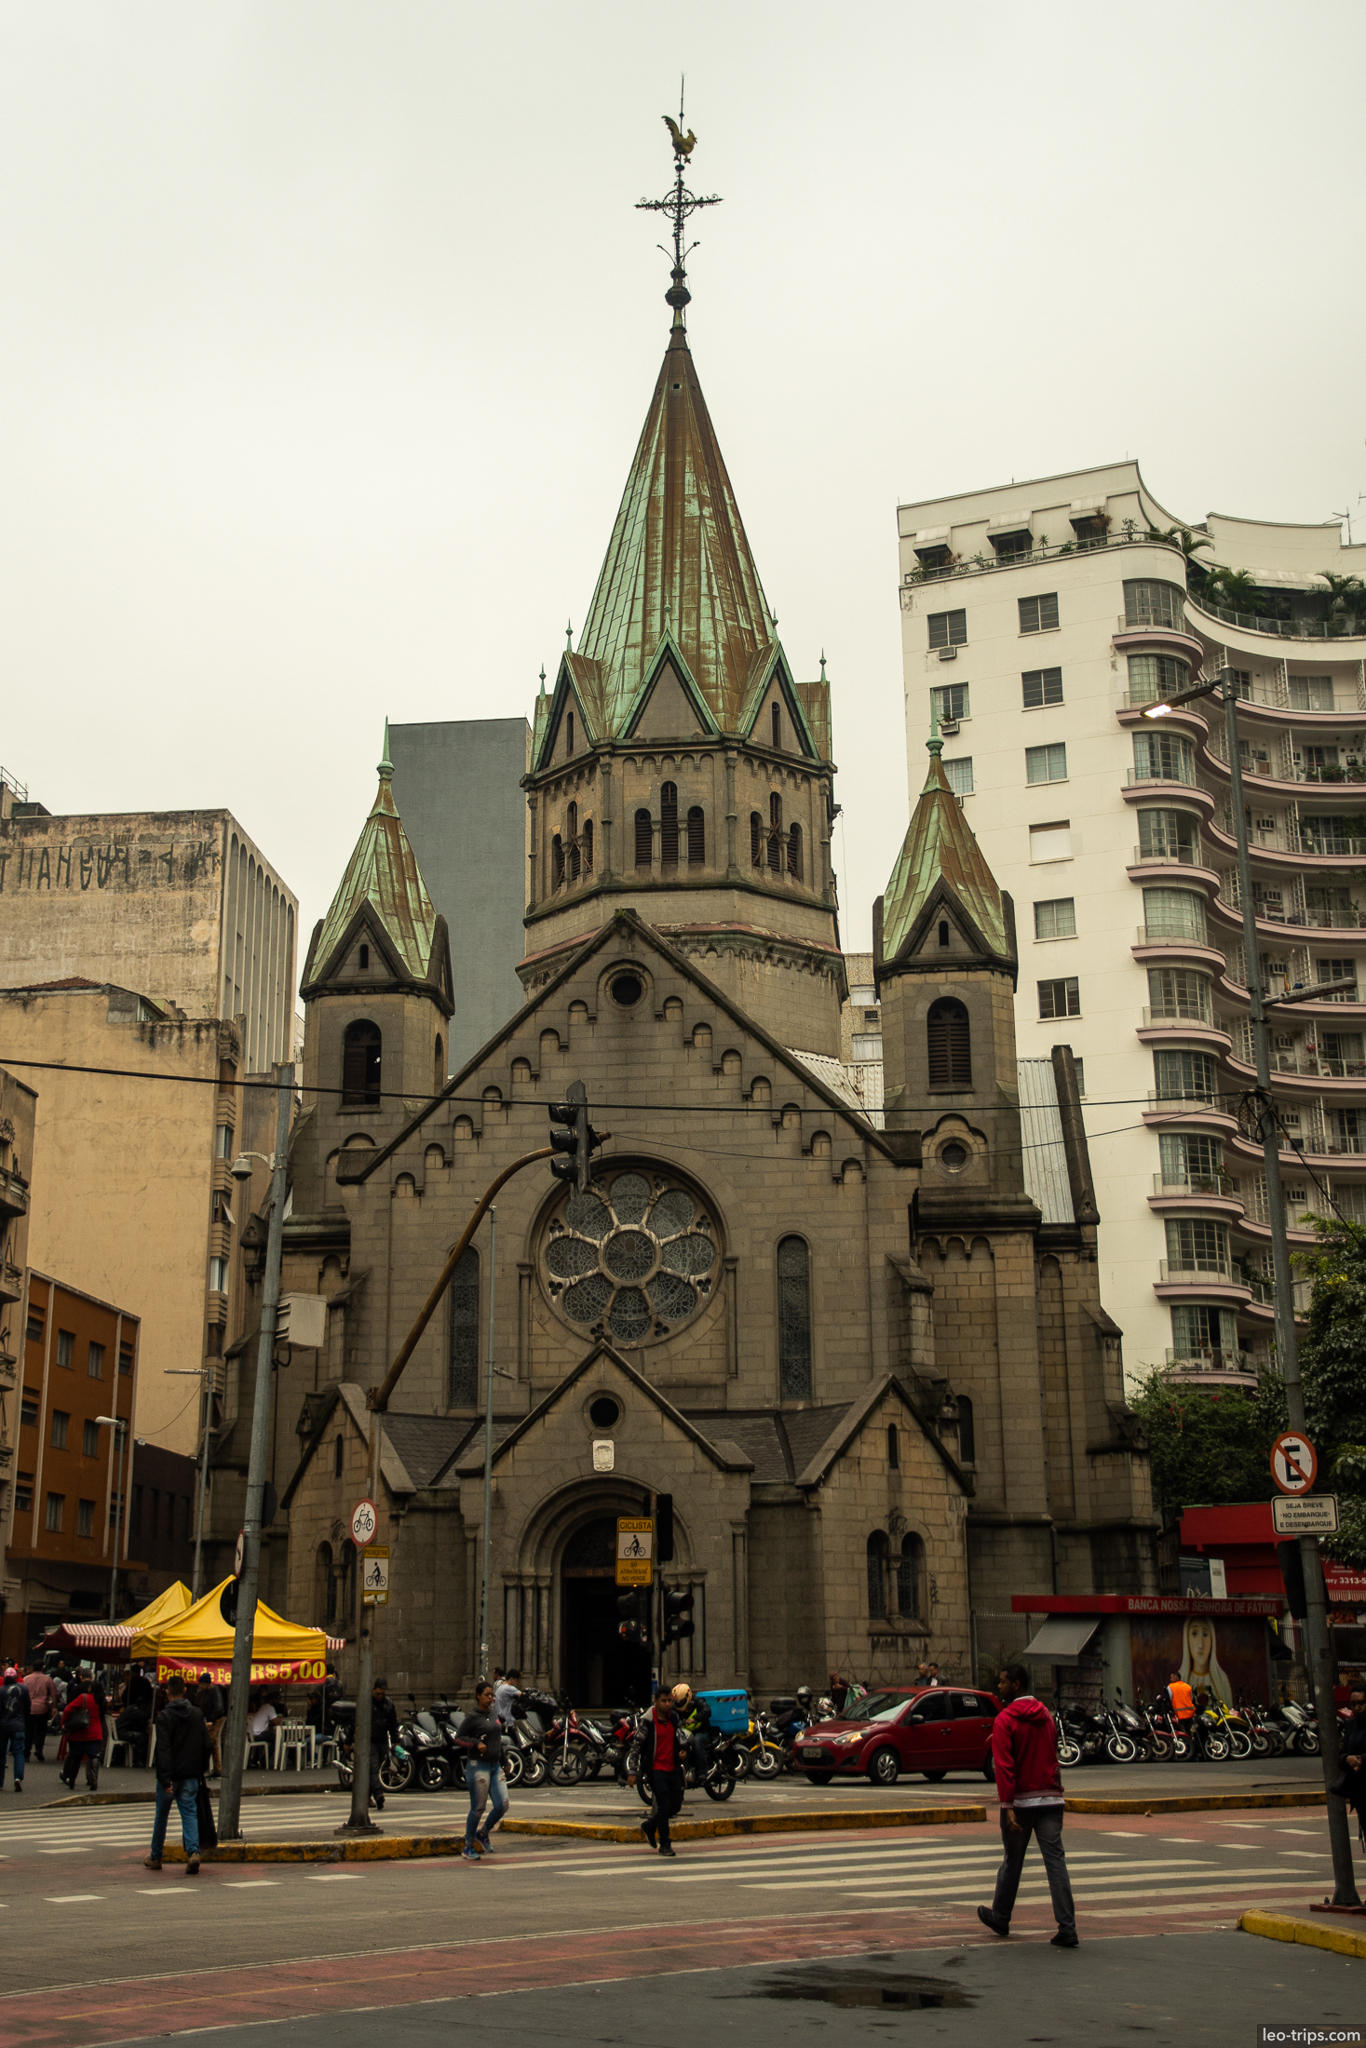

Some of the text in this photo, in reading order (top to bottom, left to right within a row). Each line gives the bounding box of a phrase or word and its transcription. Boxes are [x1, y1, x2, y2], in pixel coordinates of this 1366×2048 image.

[1284, 1445, 1302, 1482] E
[364, 1548, 388, 1556] PEDESTRE
[1128, 1598, 1277, 1613] BANCA NOSSA SENHORA DE FÁTIMA
[158, 1665, 197, 1681] Pastel
[217, 1668, 231, 1682] Fe
[251, 1661, 326, 1680] R$5,00
